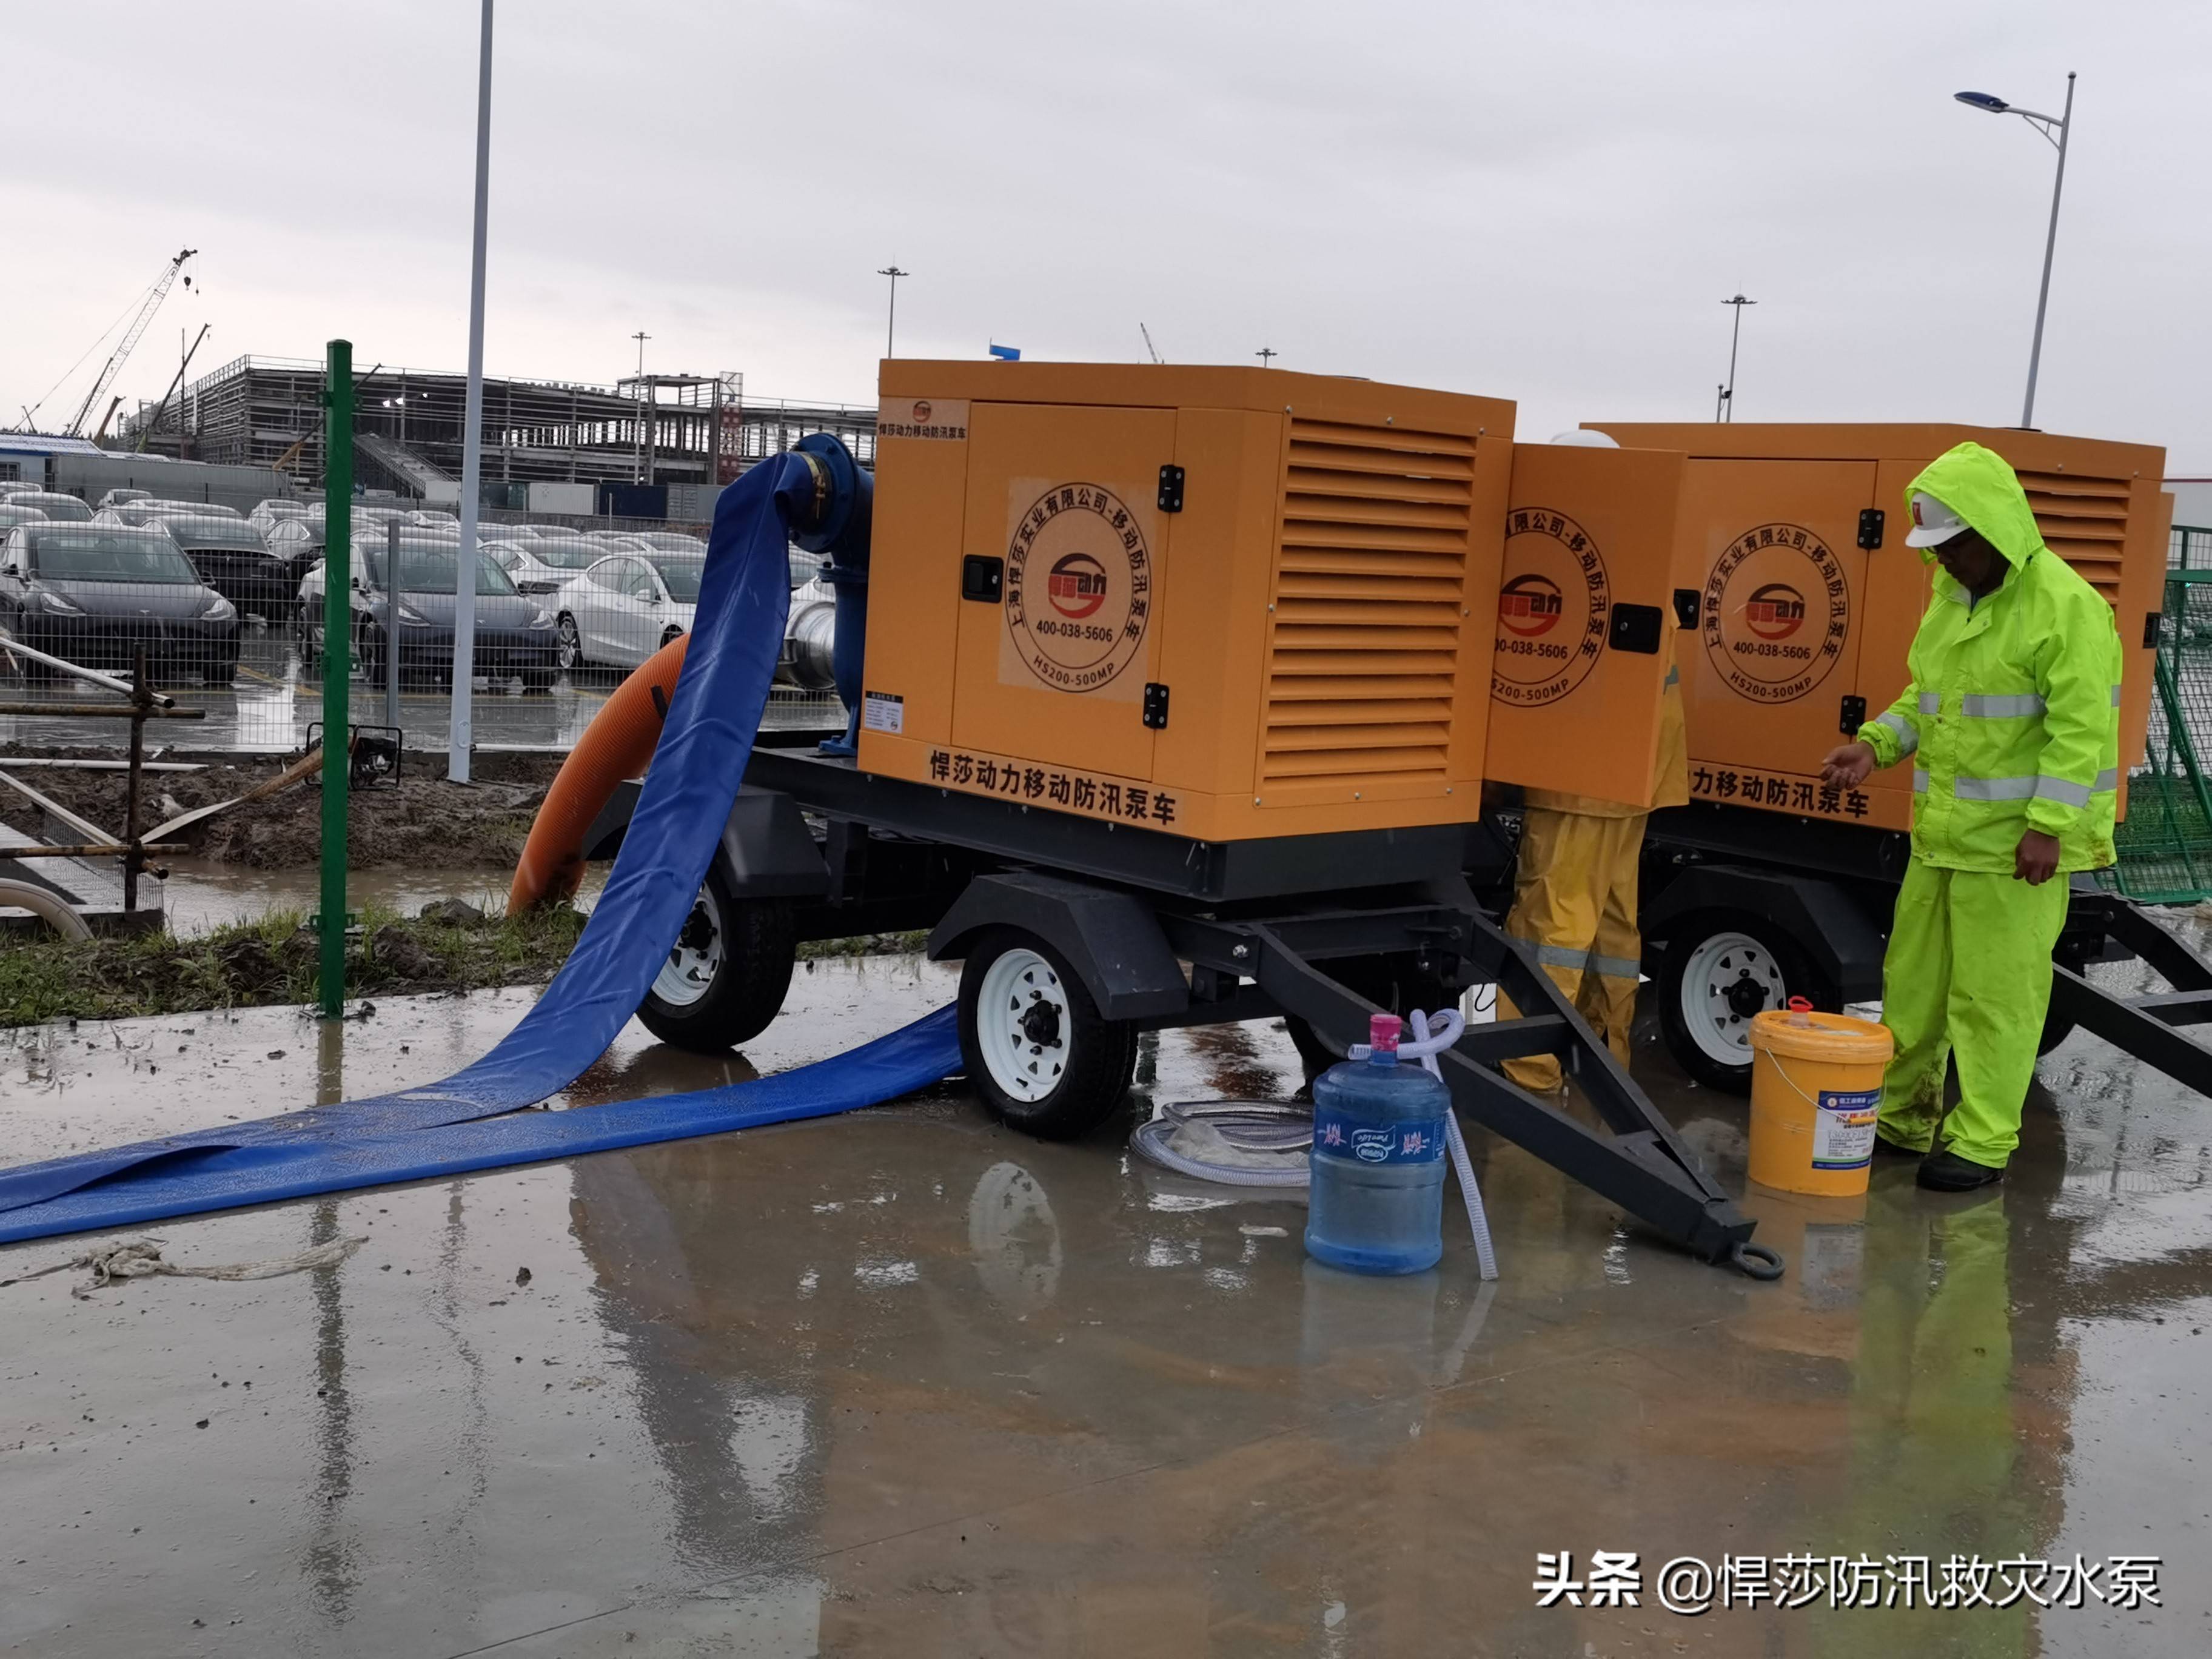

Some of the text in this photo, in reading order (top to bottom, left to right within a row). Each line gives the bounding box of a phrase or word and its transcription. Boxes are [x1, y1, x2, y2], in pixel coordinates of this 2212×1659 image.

[879, 424, 966, 439] 悍莎动力移动防汛泵车
[1505, 512, 1607, 659] 限公司-移动防汛泵车
[1036, 620, 1113, 642] 400-038-5606
[1734, 642, 1811, 660] 400-038-5606
[1034, 655, 1115, 686] HS200-500MP
[1730, 671, 1813, 698] HS200-500MP
[930, 749, 1176, 825] 悍莎动力移动防汛泵车
[1687, 767, 1869, 819] 力移动防汛泵车
